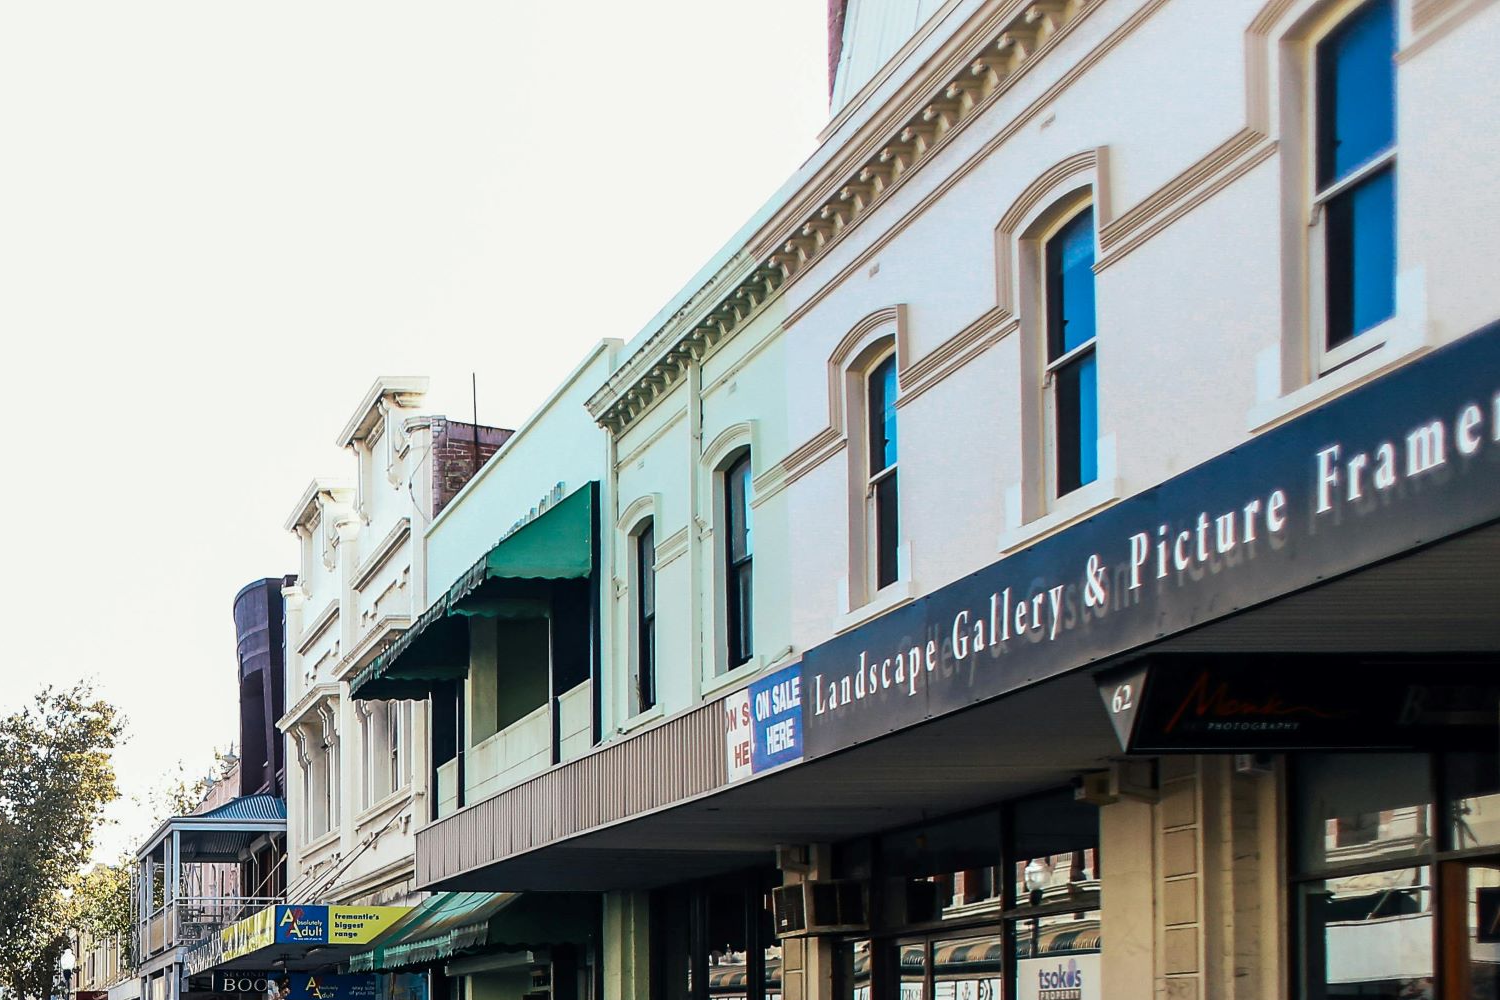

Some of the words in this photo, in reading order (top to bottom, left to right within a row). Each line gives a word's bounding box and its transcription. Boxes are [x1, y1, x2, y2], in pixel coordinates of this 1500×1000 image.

[813, 638, 937, 717] Landscape
[951, 583, 1066, 660] Gallery
[1084, 552, 1108, 608] &
[1127, 486, 1287, 592] Picture
[1315, 392, 1500, 517] Frame
[755, 690, 770, 722] ON
[772, 676, 801, 715] SALE
[1112, 683, 1134, 714] 62
[1206, 721, 1300, 732] PHOTOGRAPHY
[766, 717, 795, 756] HERE
[334, 913, 380, 921] fremantle's
[334, 922, 364, 930] biggest
[223, 970, 266, 978] SECOND
[1040, 990, 1080, 1000] PROPERTY
